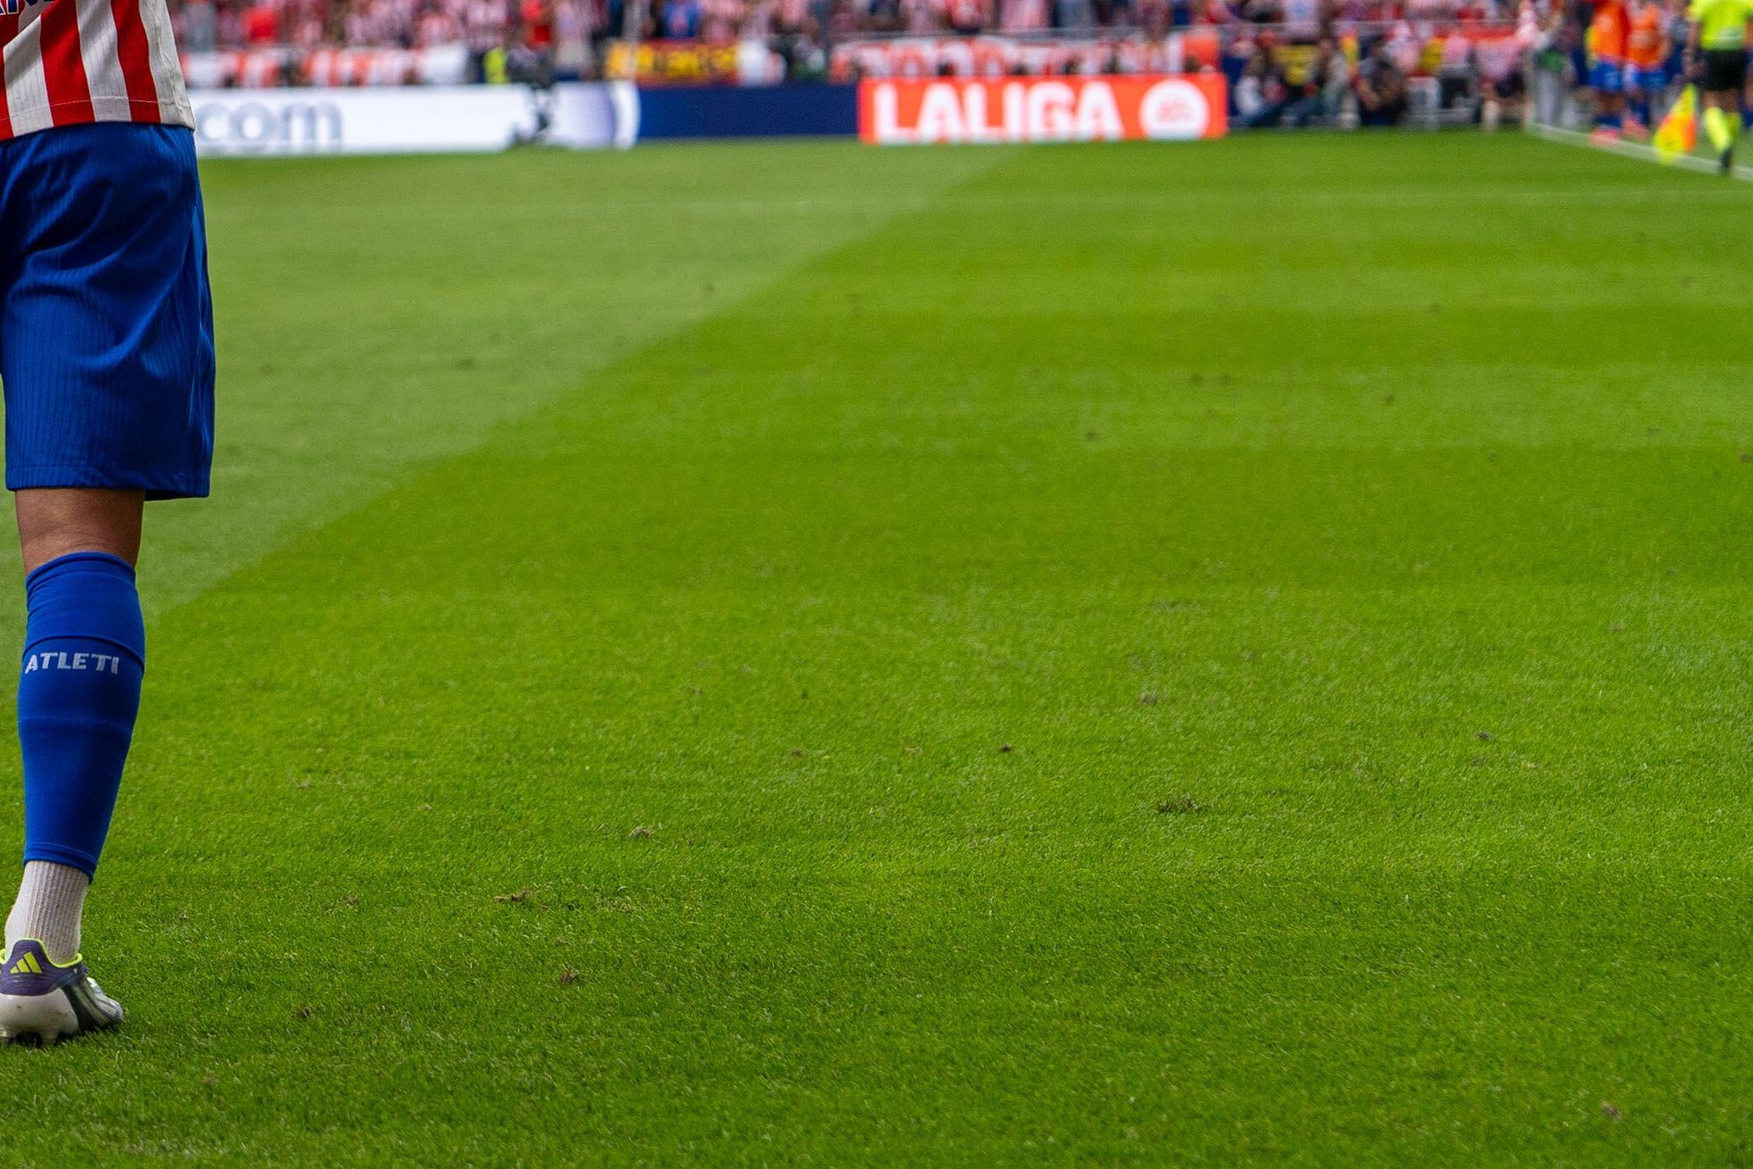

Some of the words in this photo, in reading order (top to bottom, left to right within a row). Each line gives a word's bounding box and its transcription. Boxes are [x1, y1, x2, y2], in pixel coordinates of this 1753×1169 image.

[195, 101, 342, 143] com
[873, 70, 1127, 145] LALIGA
[24, 652, 121, 676] ATLETI
